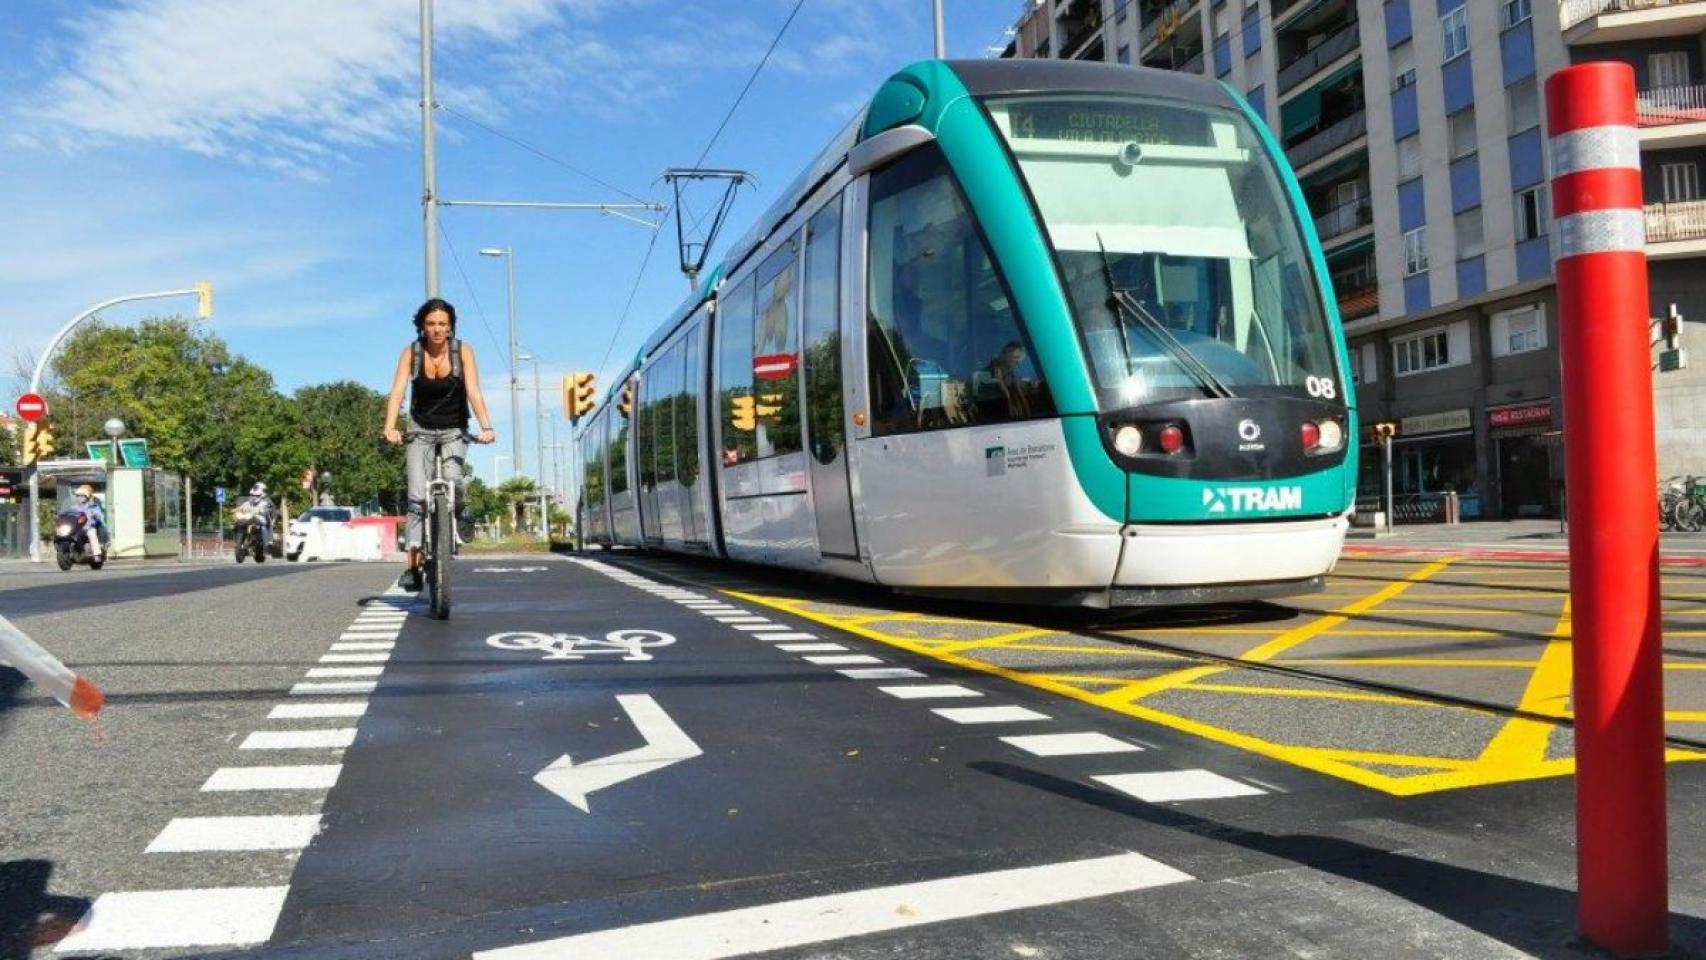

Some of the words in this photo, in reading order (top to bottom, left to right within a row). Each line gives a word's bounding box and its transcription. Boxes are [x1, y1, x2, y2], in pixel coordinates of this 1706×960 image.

[1069, 111, 1161, 129] CIUTADELLA
[1305, 375, 1336, 399] 08
[1227, 486, 1302, 512] TRAM
